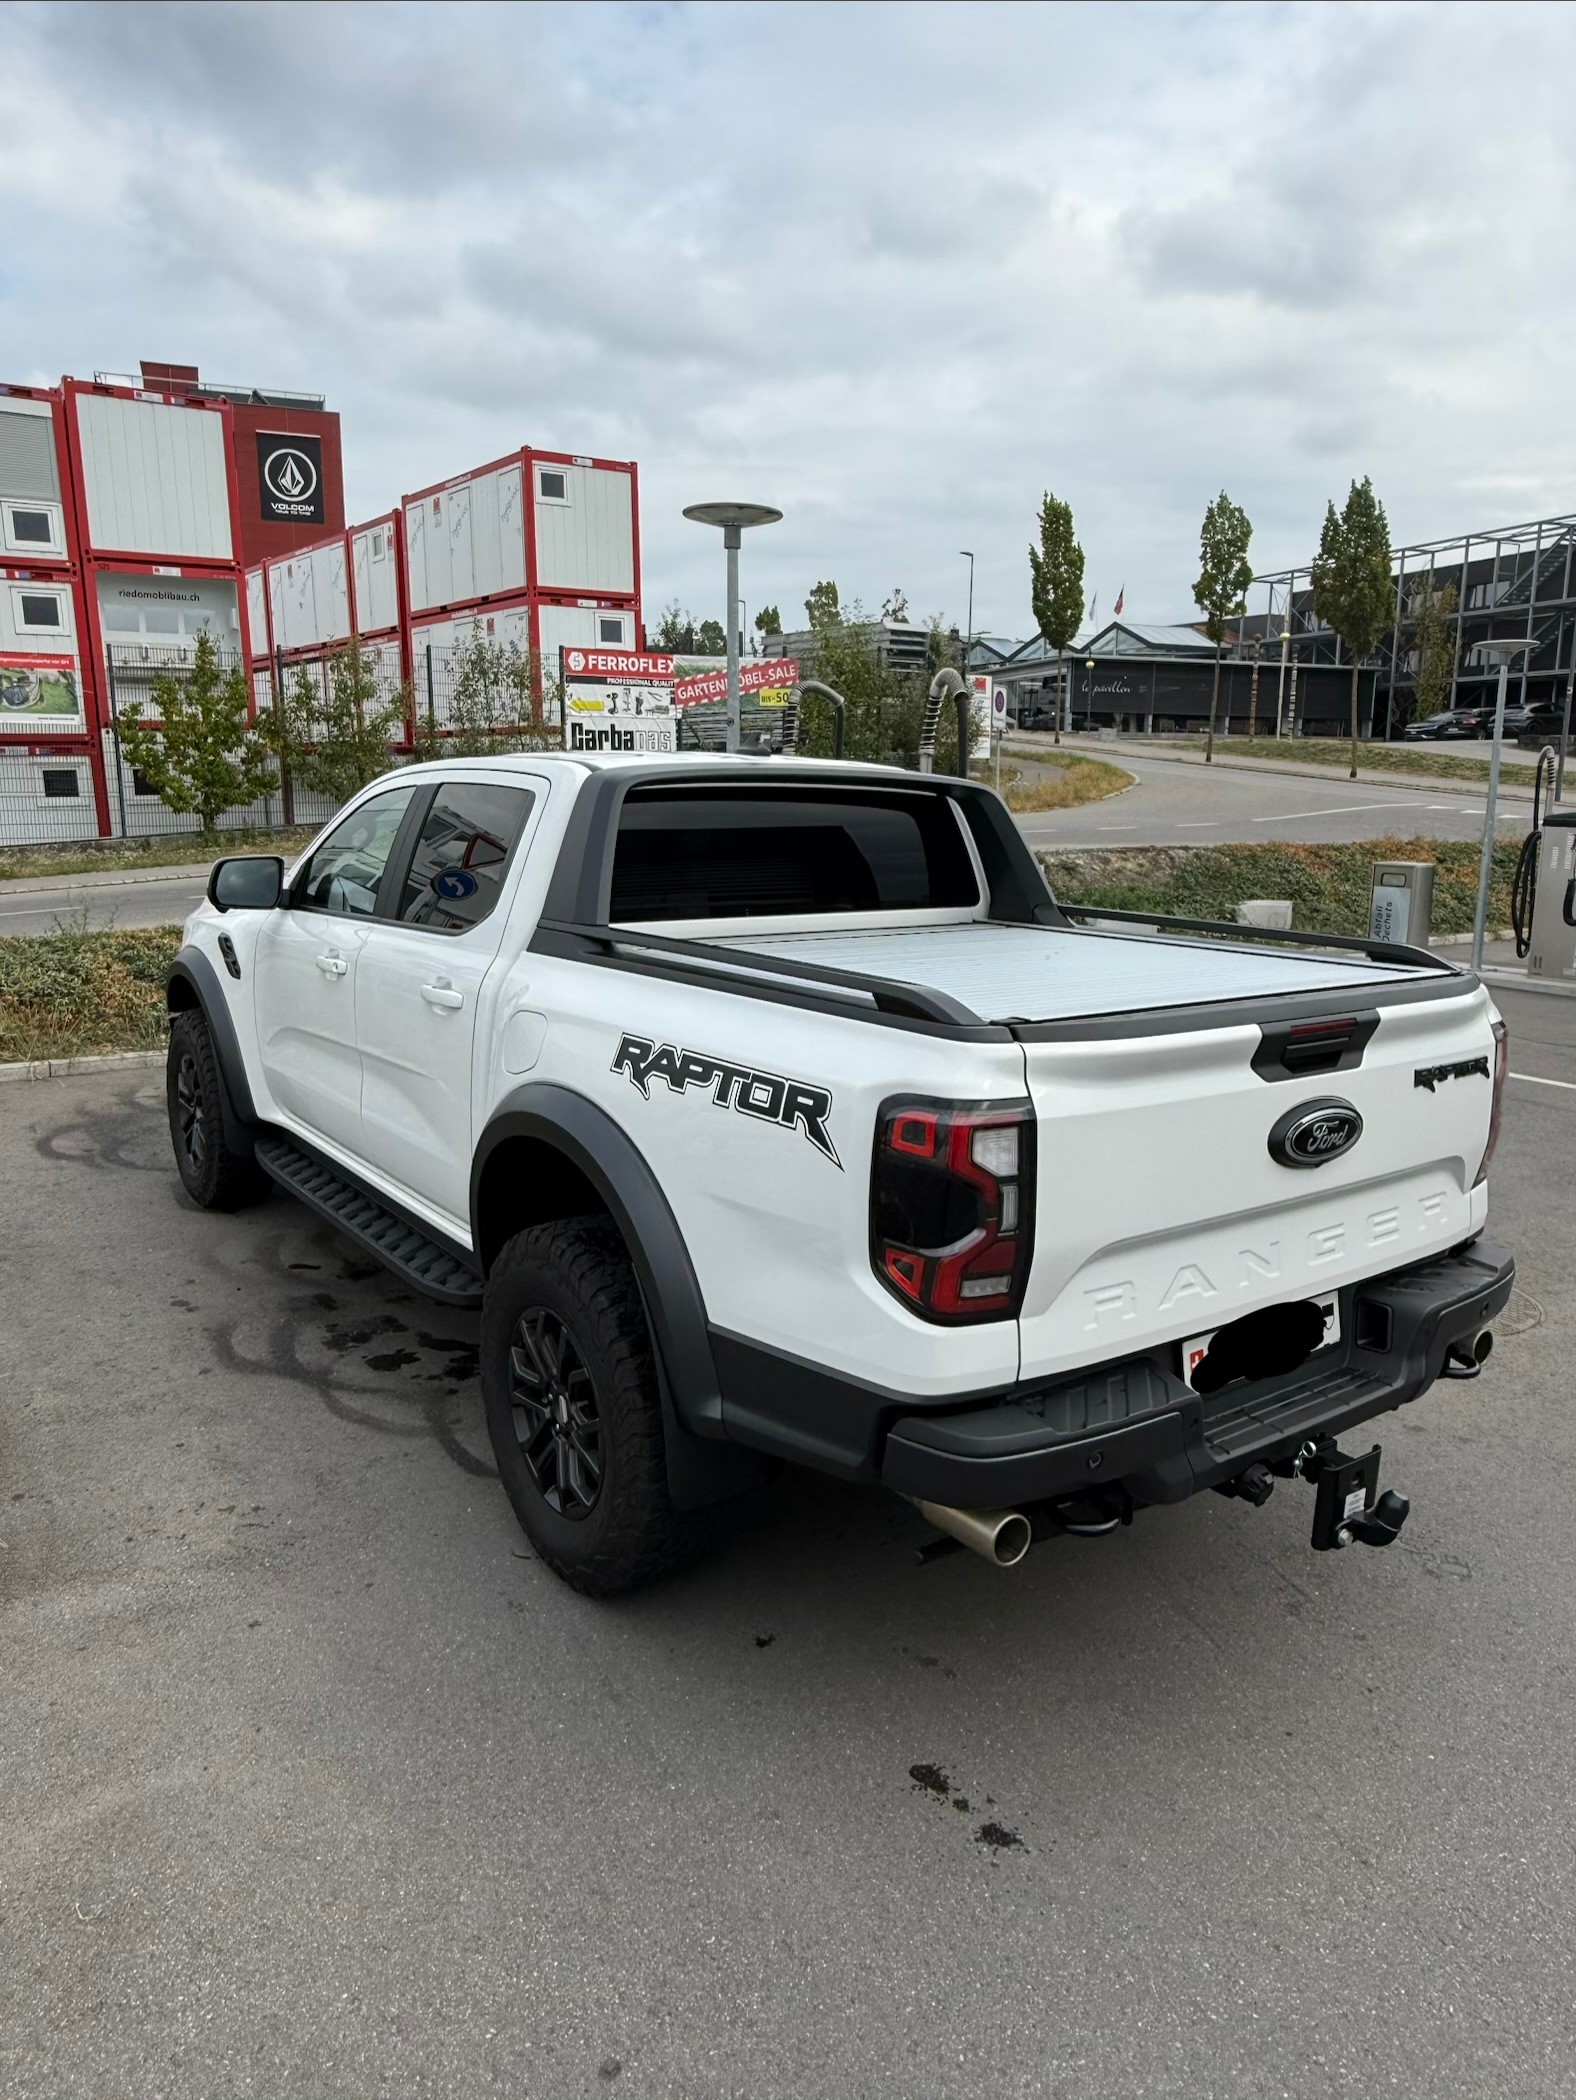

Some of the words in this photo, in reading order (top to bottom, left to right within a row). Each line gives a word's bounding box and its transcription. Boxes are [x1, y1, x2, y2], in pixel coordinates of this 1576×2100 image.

[271, 502, 315, 512] VOLCOM
[607, 678, 651, 687] PROFESSIONAL
[1374, 904, 1384, 939] Abfall
[1414, 1056, 1490, 1093] RAPTOR
[610, 1032, 845, 1173] RAPTOR
[1307, 1120, 1349, 1152] Ford
[1083, 1191, 1449, 1332] RANGER
